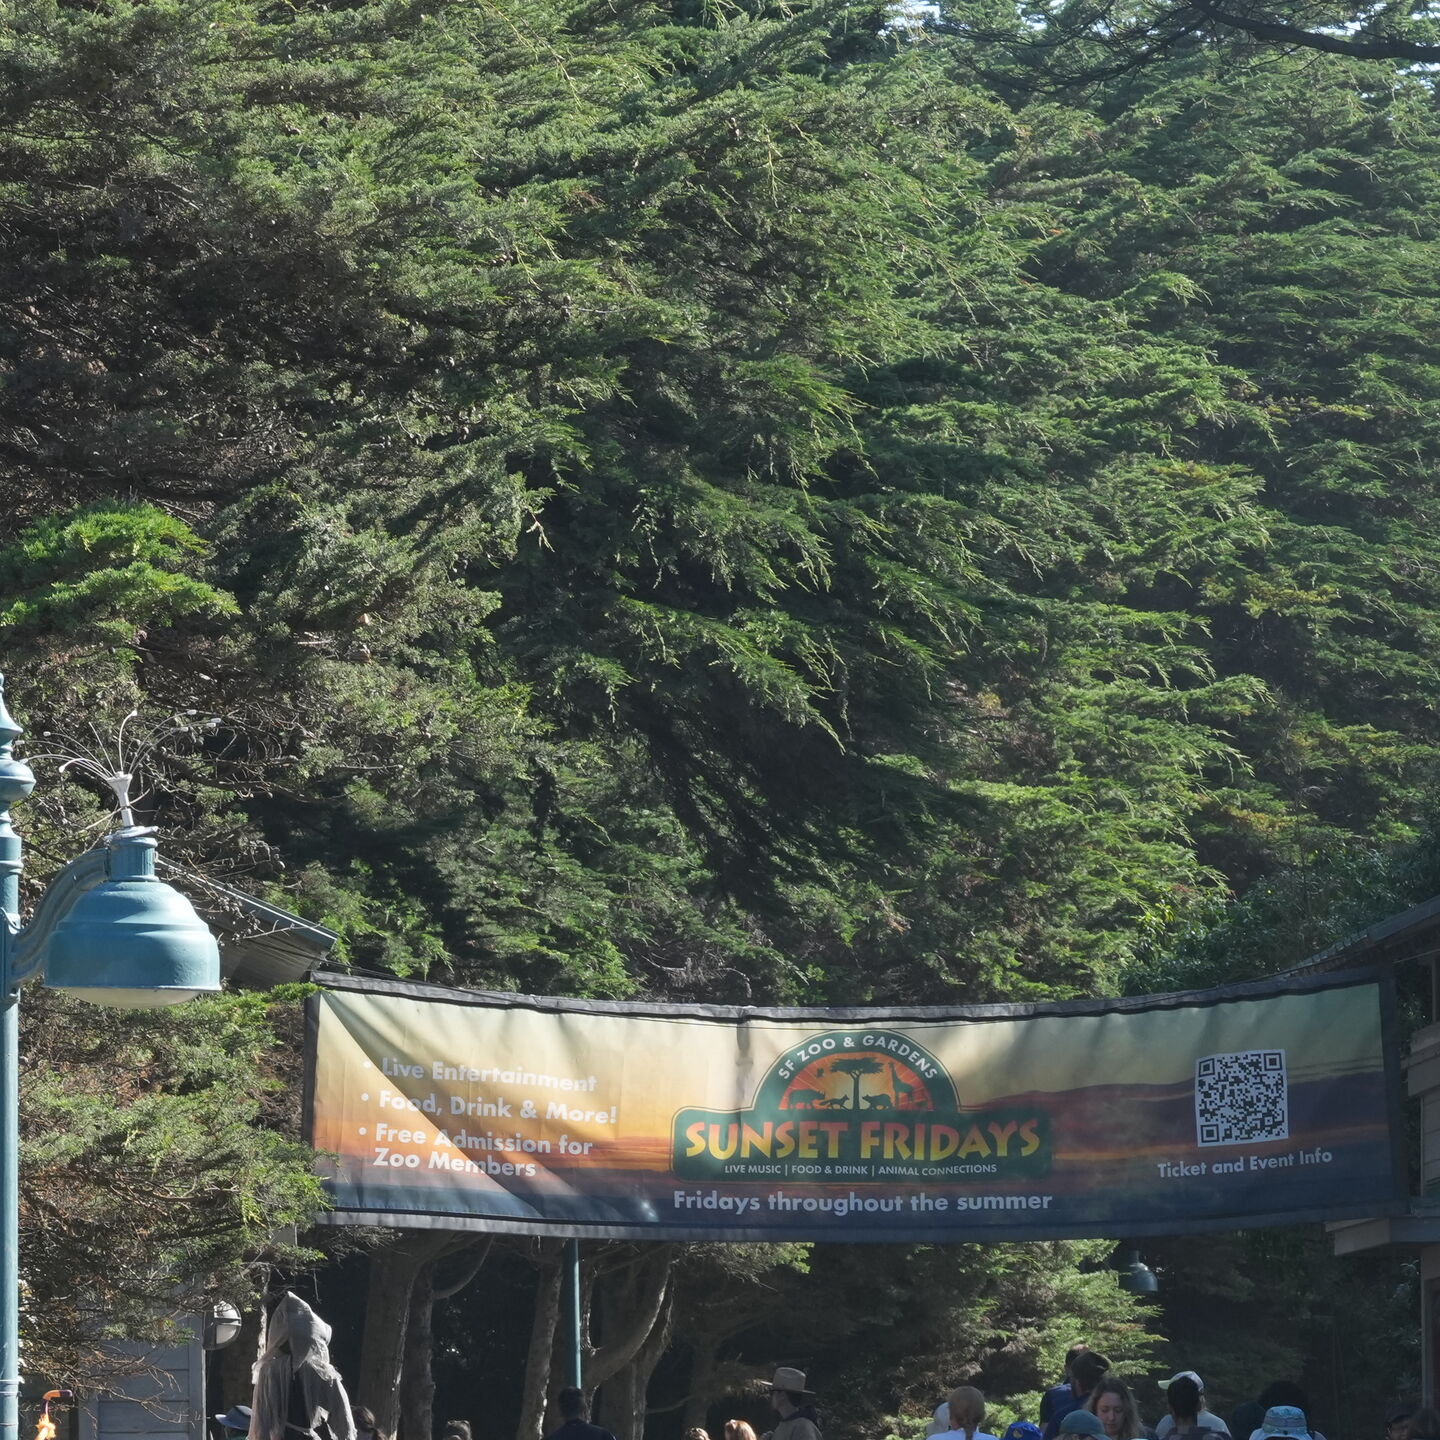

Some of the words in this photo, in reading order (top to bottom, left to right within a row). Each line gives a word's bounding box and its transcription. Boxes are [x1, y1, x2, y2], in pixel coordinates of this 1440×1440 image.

[381, 1056, 424, 1080] Live
[432, 1061, 598, 1093] Entertainment
[778, 1056, 796, 1079] SF
[796, 1038, 836, 1062] ZOO
[843, 1036, 855, 1048] &
[862, 1035, 938, 1080] GARDENS
[378, 1090, 443, 1117] Food,
[450, 1094, 512, 1119] Drink
[520, 1098, 538, 1119] &
[545, 1100, 618, 1125] More!
[374, 1122, 426, 1146] Free
[434, 1128, 551, 1155] Admission
[559, 1136, 593, 1157] for
[685, 1120, 850, 1160] SUNSET
[861, 1118, 1041, 1161] FRIDAYS
[373, 1147, 421, 1169] Zoo
[428, 1153, 536, 1178] Members
[724, 1164, 746, 1174] LIVE
[748, 1164, 781, 1175] MUSIC
[791, 1164, 822, 1175] FOOD
[824, 1164, 833, 1175] &
[834, 1164, 868, 1175] DRINK
[878, 1165, 920, 1176] ANIMAL
[921, 1164, 998, 1176] CONNECTIONS
[1157, 1160, 1208, 1179] Ticket
[1211, 1157, 1244, 1176] and
[1250, 1153, 1296, 1171] Event
[1299, 1147, 1332, 1167] Info
[673, 1190, 760, 1215] Fridays
[768, 1192, 903, 1217] throughout
[910, 1192, 948, 1212] the
[957, 1193, 1052, 1211] summer
